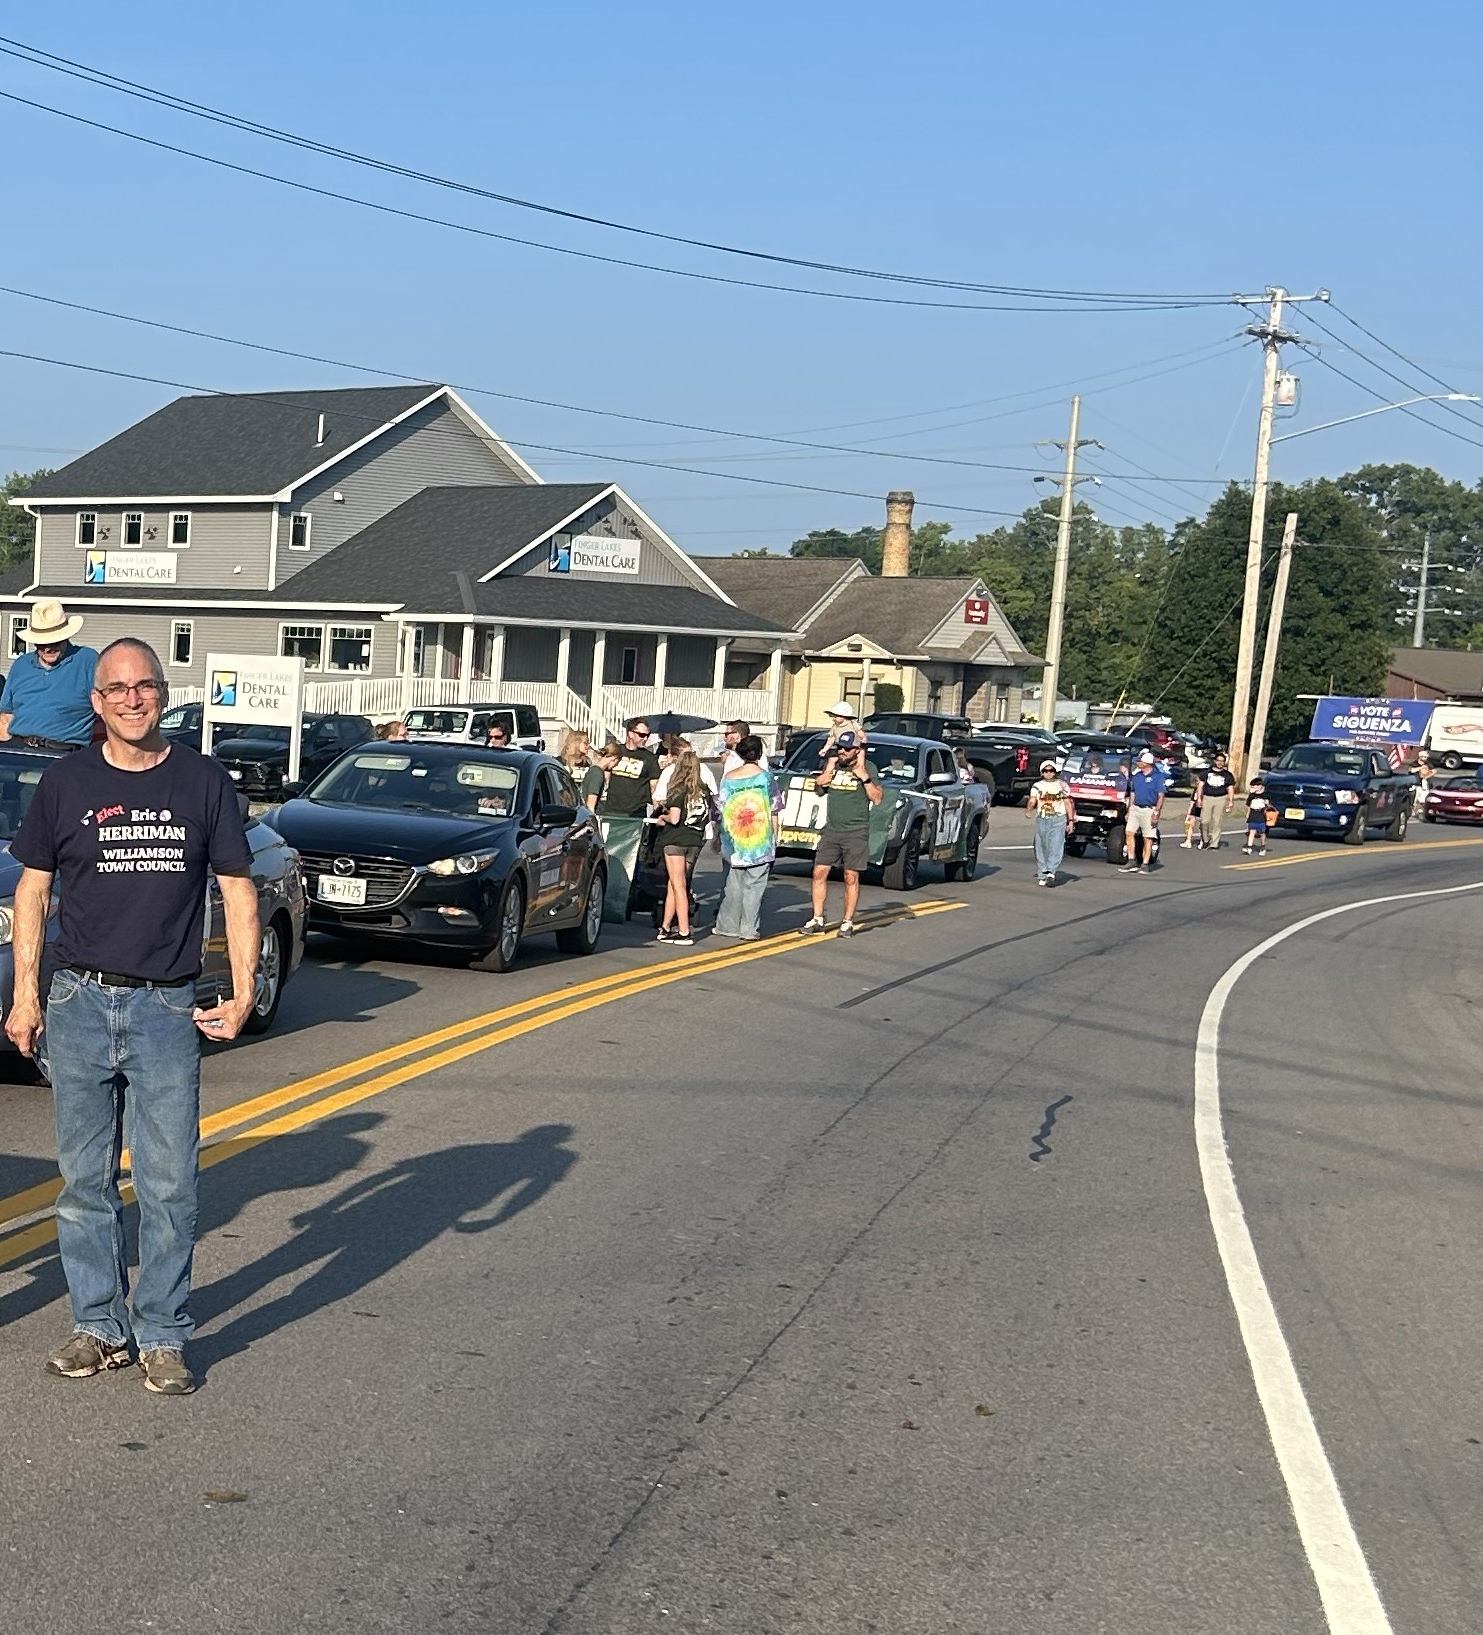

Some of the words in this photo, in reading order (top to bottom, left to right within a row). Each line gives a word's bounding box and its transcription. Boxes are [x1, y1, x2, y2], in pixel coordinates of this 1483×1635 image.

[574, 552, 610, 567] DENTAL
[611, 555, 636, 569] CARE
[108, 566, 145, 578] DENTAL
[147, 566, 173, 579] CARE
[242, 682, 289, 696] DENTAL
[248, 695, 279, 709] CARE
[1359, 705, 1390, 717] VOTE
[1331, 715, 1411, 733] SIGUENZA
[96, 804, 125, 824] Elect
[130, 808, 157, 821] Eric
[98, 825, 186, 842] HERRIMAN
[102, 847, 184, 860] WILLIAMSON
[96, 860, 135, 872] TOWN
[135, 860, 186, 872] COUNCIL
